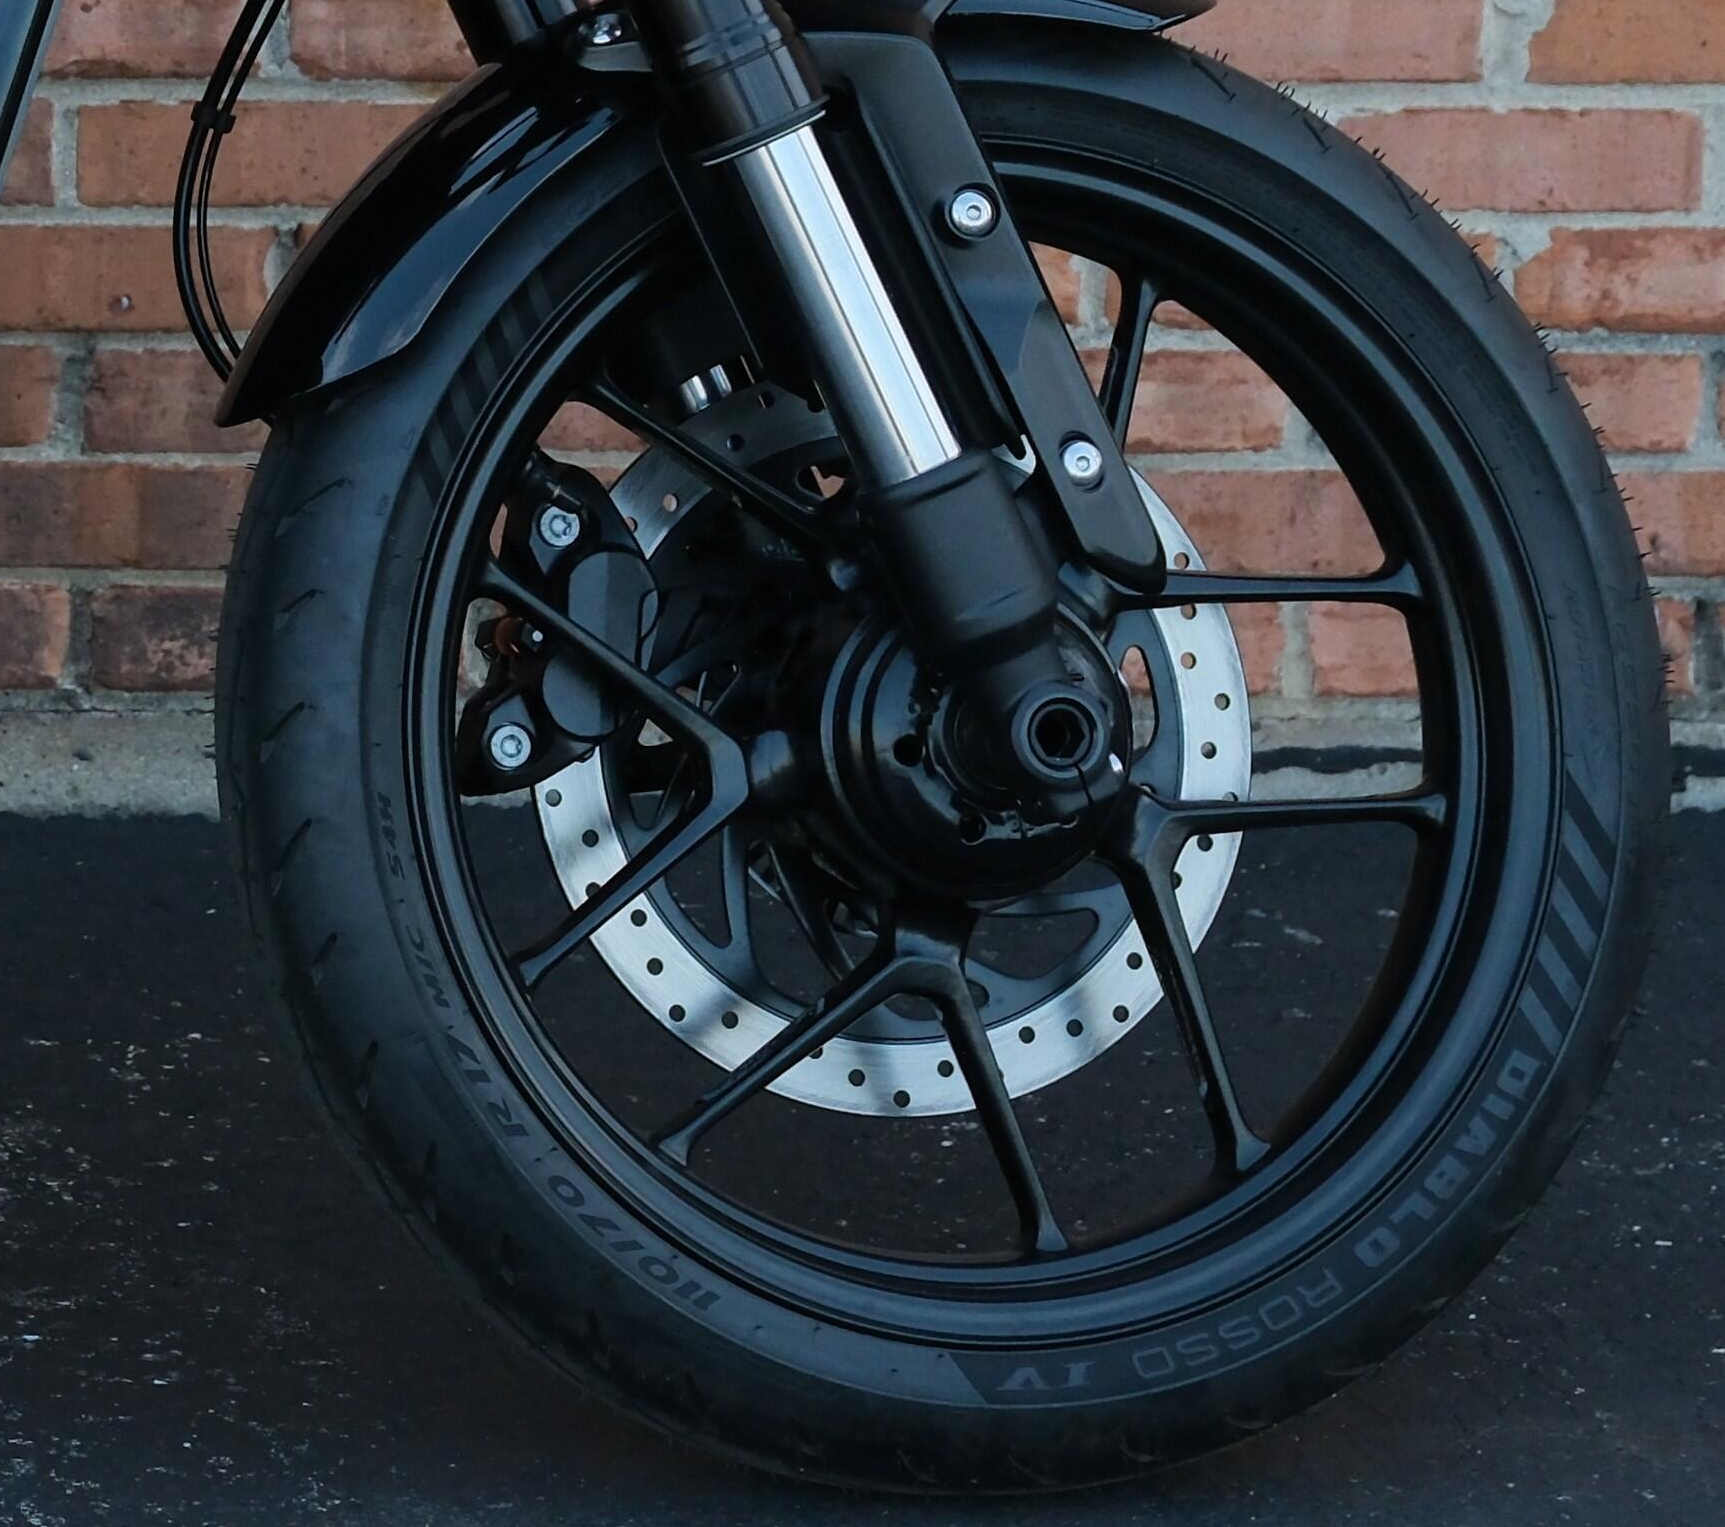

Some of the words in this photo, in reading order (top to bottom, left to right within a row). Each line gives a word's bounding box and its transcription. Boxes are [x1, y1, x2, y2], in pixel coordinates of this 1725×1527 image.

[1353, 1049, 1544, 1268] DIABLO
[547, 1174, 722, 1311] 110/70
[994, 1360, 1096, 1391] IV
[1132, 1269, 1343, 1380] ROSSO
